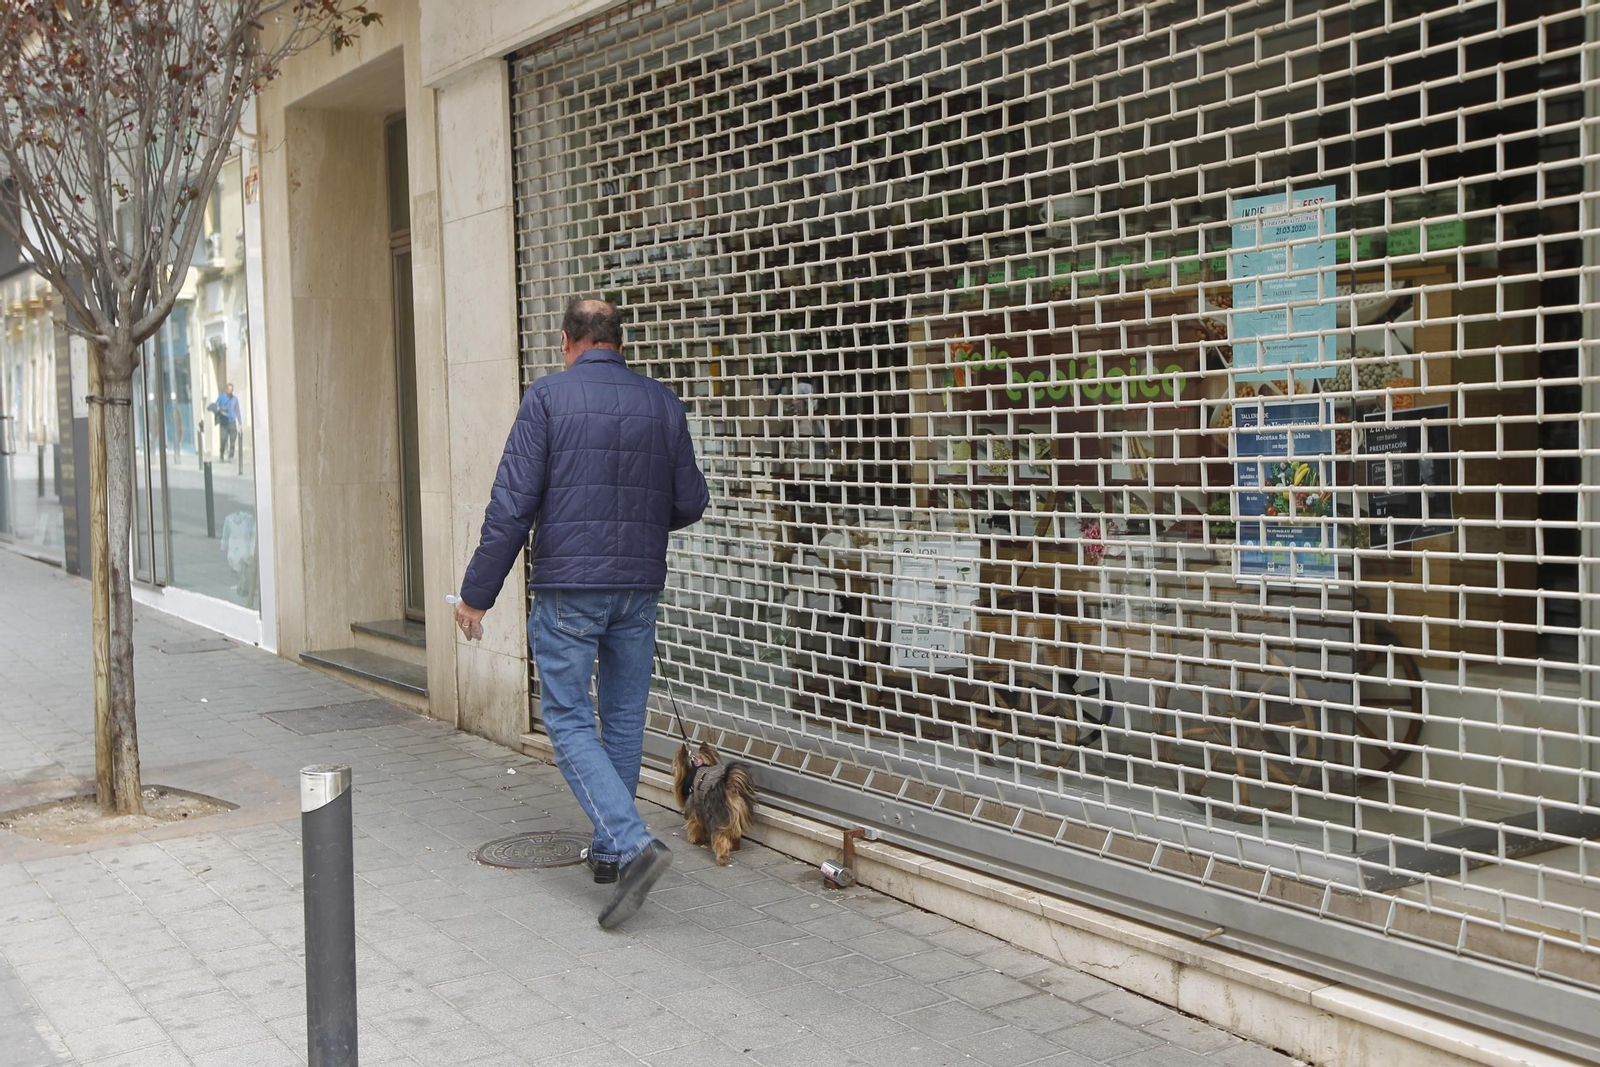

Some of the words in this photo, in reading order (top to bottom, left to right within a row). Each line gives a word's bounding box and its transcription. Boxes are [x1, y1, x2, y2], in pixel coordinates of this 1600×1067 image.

[1241, 206, 1265, 221] INDIE
[1275, 224, 1307, 236] 21.03.2020
[1255, 433, 1278, 441] Recetas
[1369, 441, 1408, 452] PRESENTACIÓN
[930, 643, 966, 660] Tr
